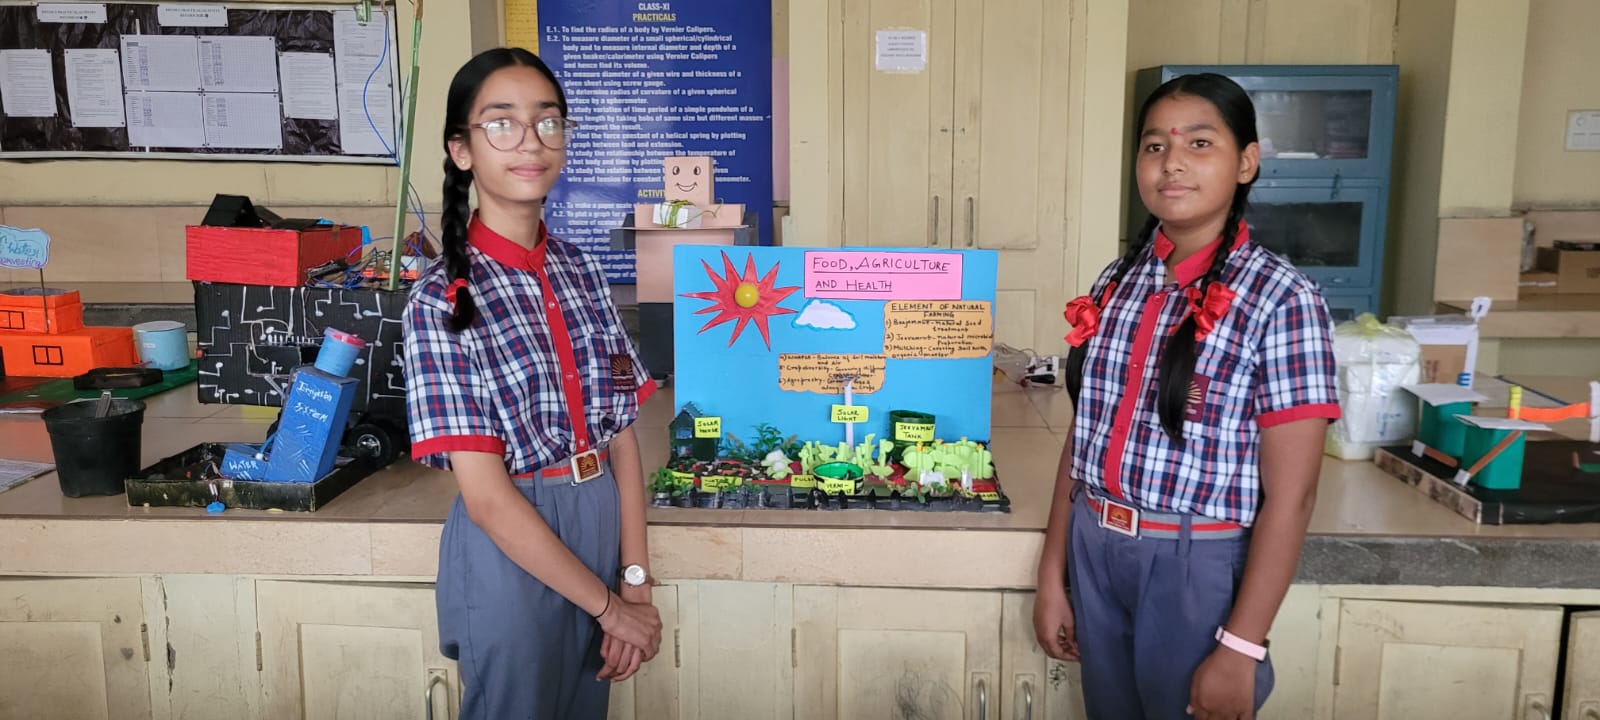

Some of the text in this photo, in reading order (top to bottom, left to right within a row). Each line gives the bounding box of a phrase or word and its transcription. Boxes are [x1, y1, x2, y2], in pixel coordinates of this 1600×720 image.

[632, 13, 676, 21] PRACTICALS
[814, 257, 950, 272] FOOD, AGRICULTURE
[816, 280, 892, 290] AND HEALTH
[229, 460, 258, 470] WATER
